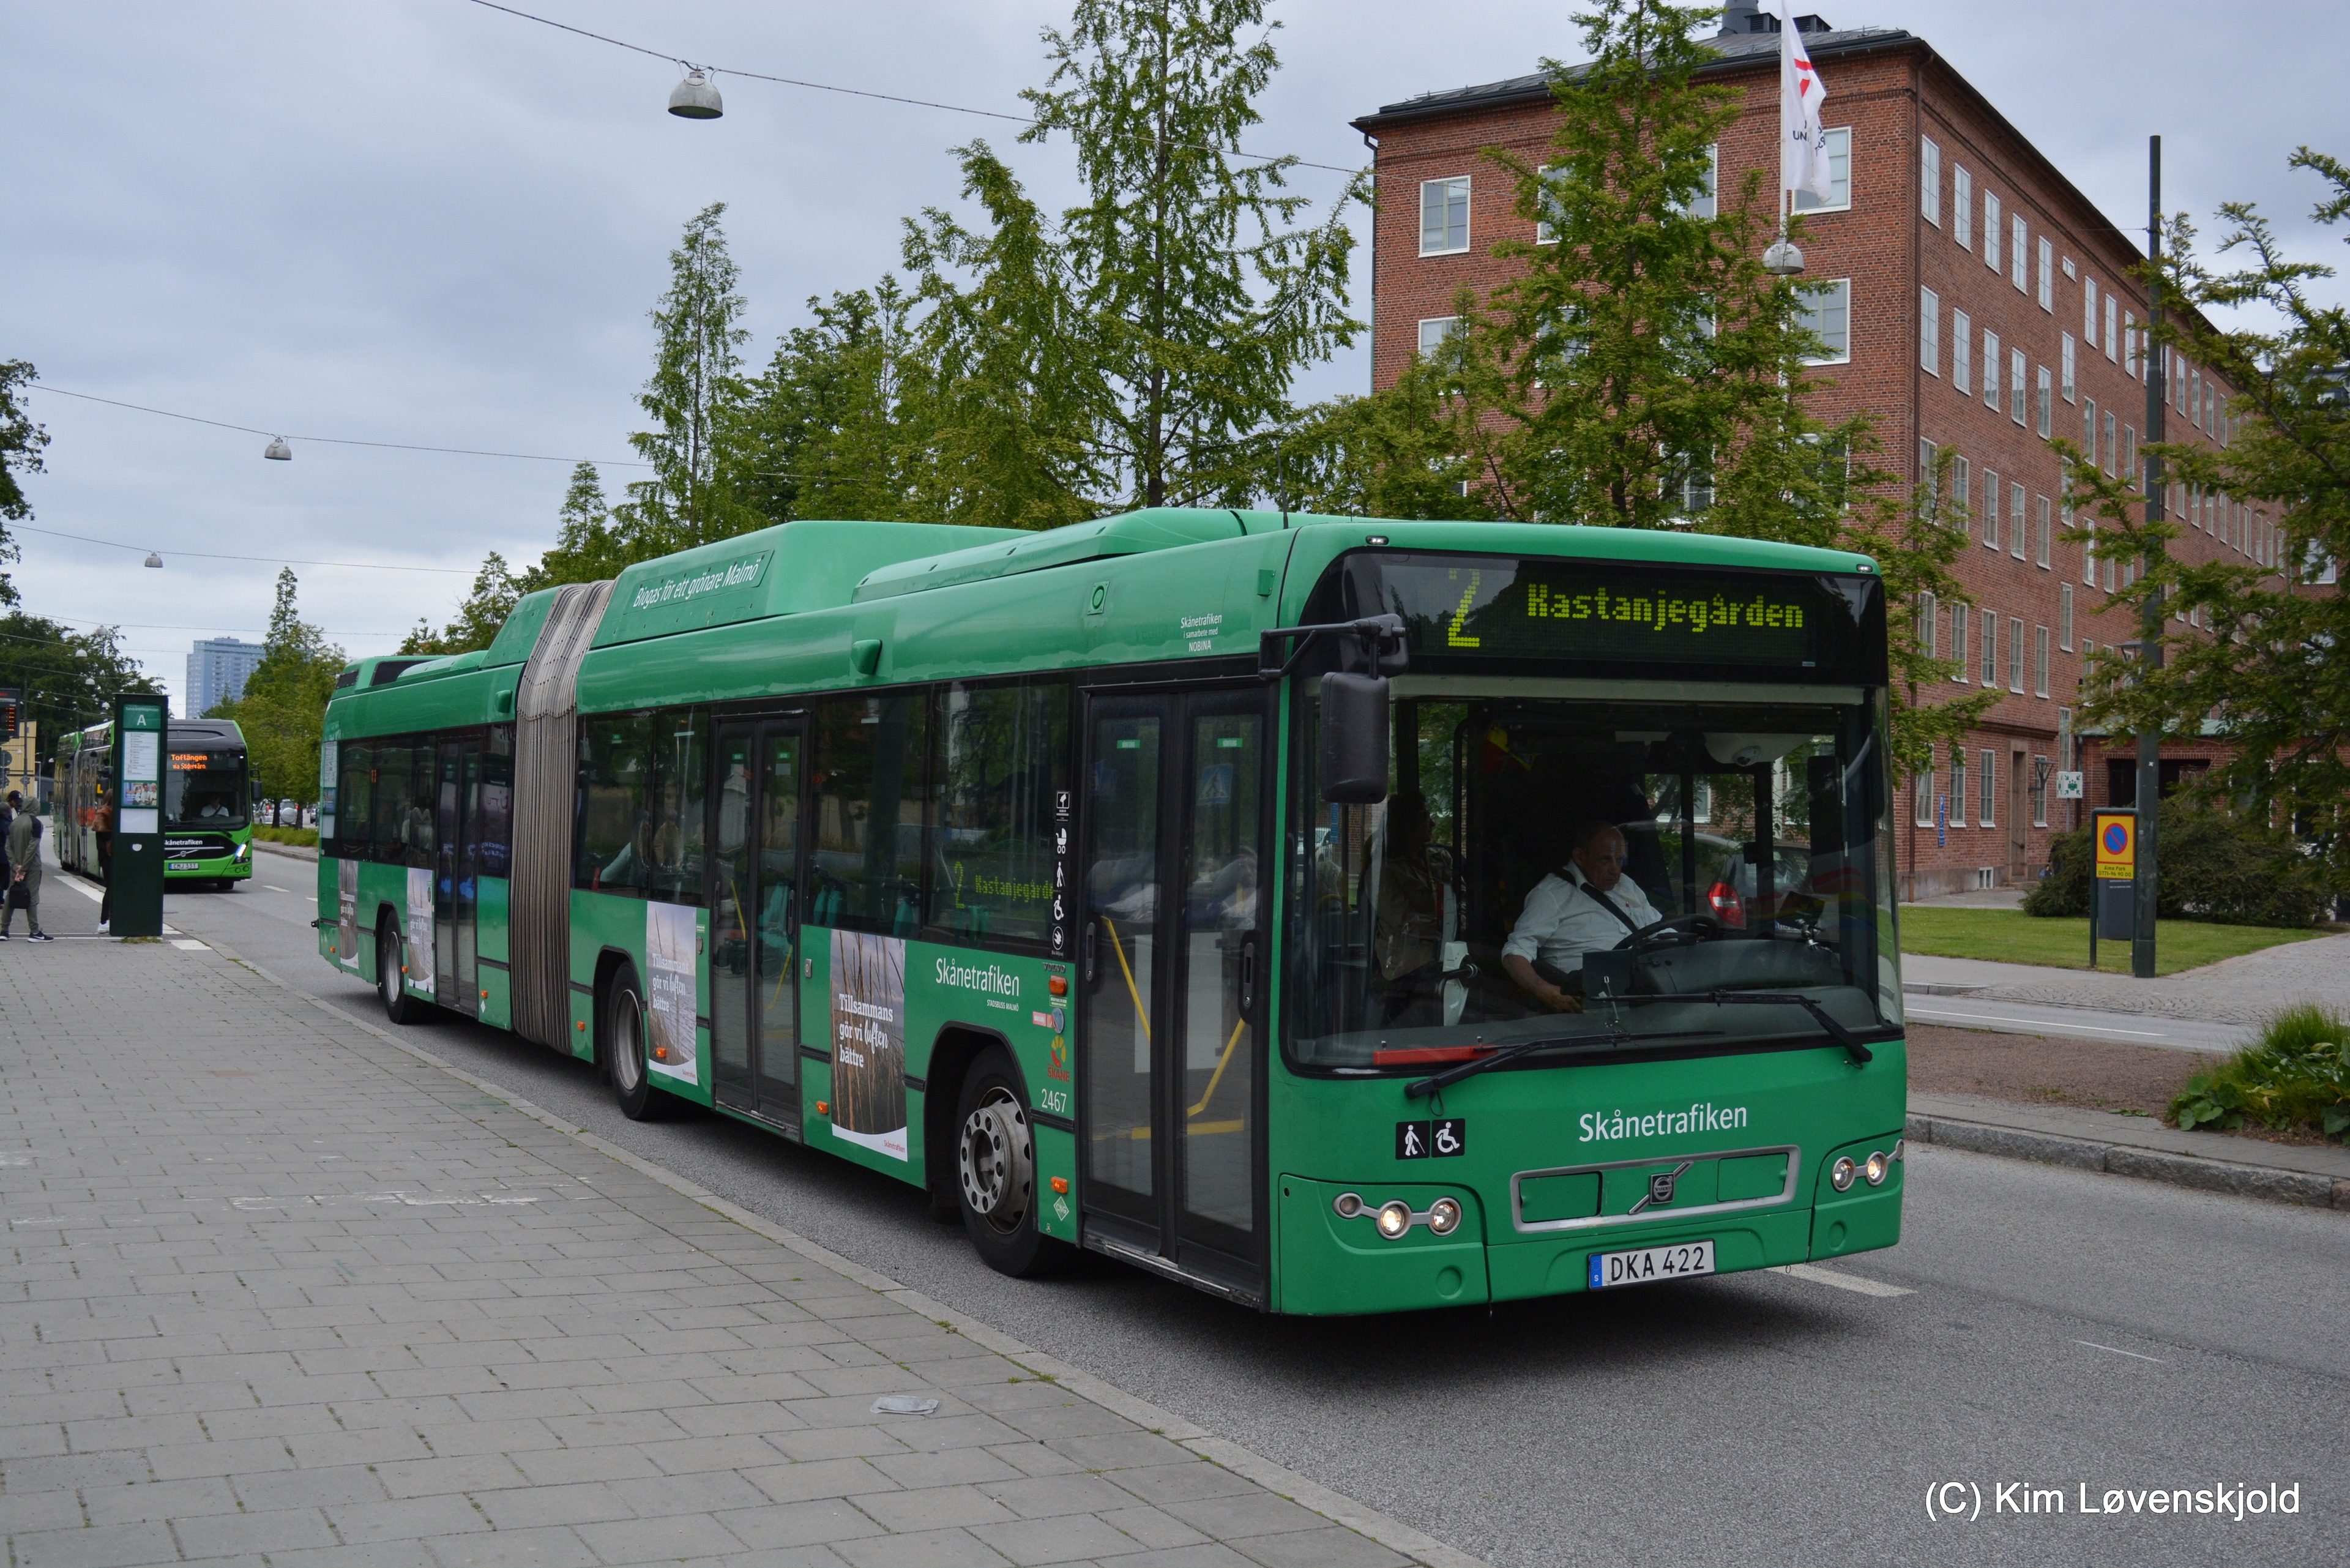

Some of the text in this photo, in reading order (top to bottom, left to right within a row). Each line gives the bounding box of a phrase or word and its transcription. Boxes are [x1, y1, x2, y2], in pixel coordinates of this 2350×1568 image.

[633, 558, 761, 609] Biogas för ett grönare Malmö
[1448, 568, 1803, 647] 2 Kastanjegården
[1181, 613, 1222, 629] Skånetrafiken
[1186, 629, 1207, 638] samarbete
[1208, 627, 1218, 635] med
[1188, 640, 1211, 652] NOBINA
[136, 714, 146, 726] A
[954, 861, 965, 909] 2
[652, 953, 689, 974] Tillsammans
[652, 973, 685, 1001] gör vi luften
[936, 958, 1020, 996] Skånetrafiken
[652, 994, 670, 1012] bättre
[839, 993, 893, 1023] Tillsammans
[987, 999, 1019, 1011] STADSBUSS MALMÖ
[839, 1019, 889, 1055] gör vi luften
[840, 1044, 864, 1068] bättre
[1042, 1088, 1067, 1113] 2467
[1579, 1102, 1747, 1143] Skånetrafiken
[1056, 1203, 1067, 1214] CNG
[1610, 1246, 1705, 1282] DKA 422
